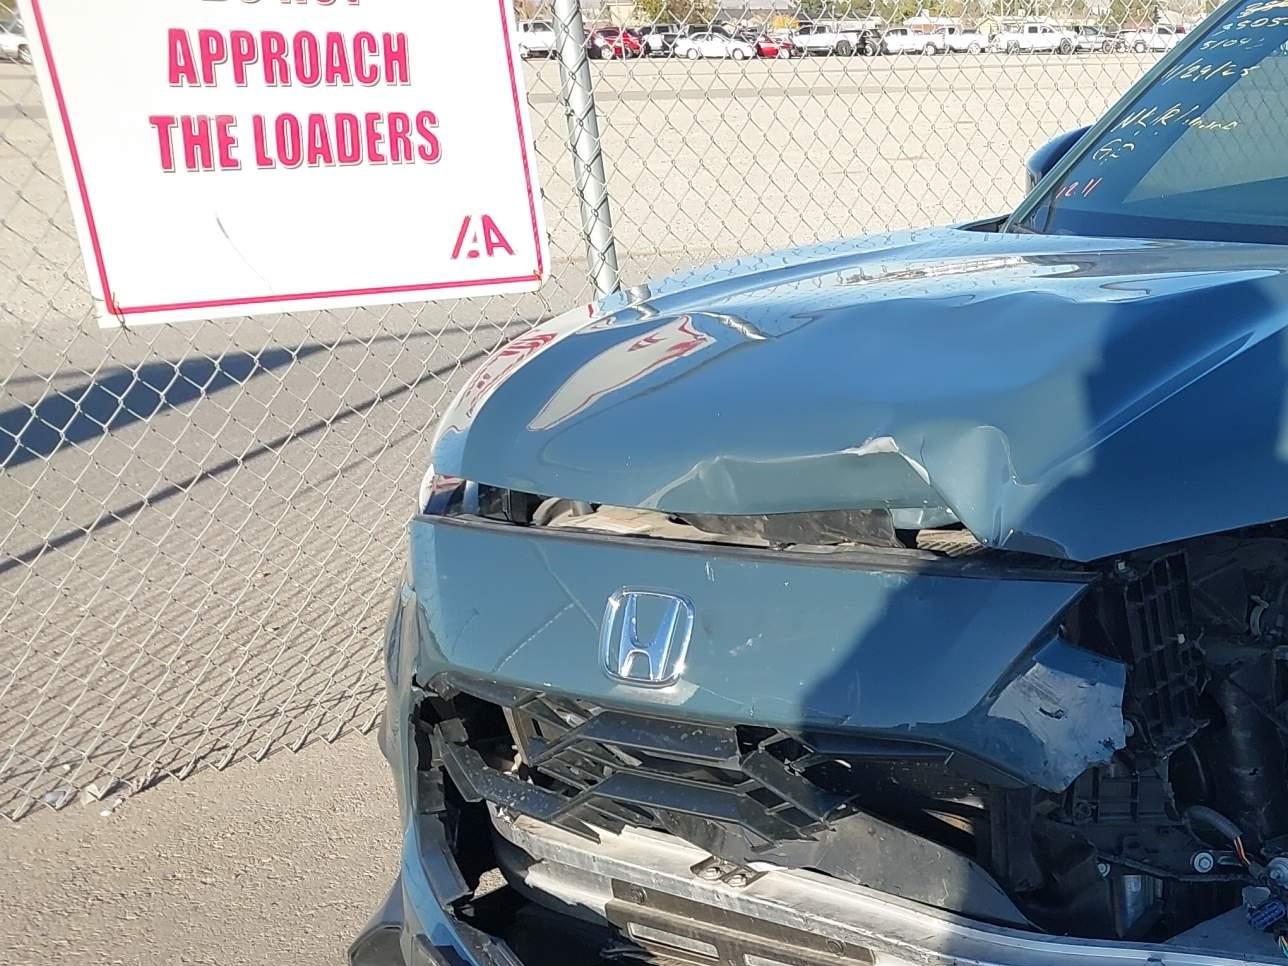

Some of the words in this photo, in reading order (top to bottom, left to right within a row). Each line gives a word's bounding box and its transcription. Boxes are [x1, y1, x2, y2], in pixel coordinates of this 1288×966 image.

[167, 28, 411, 87] APPROACH
[149, 114, 241, 173] THE
[252, 110, 442, 170] LOADERS
